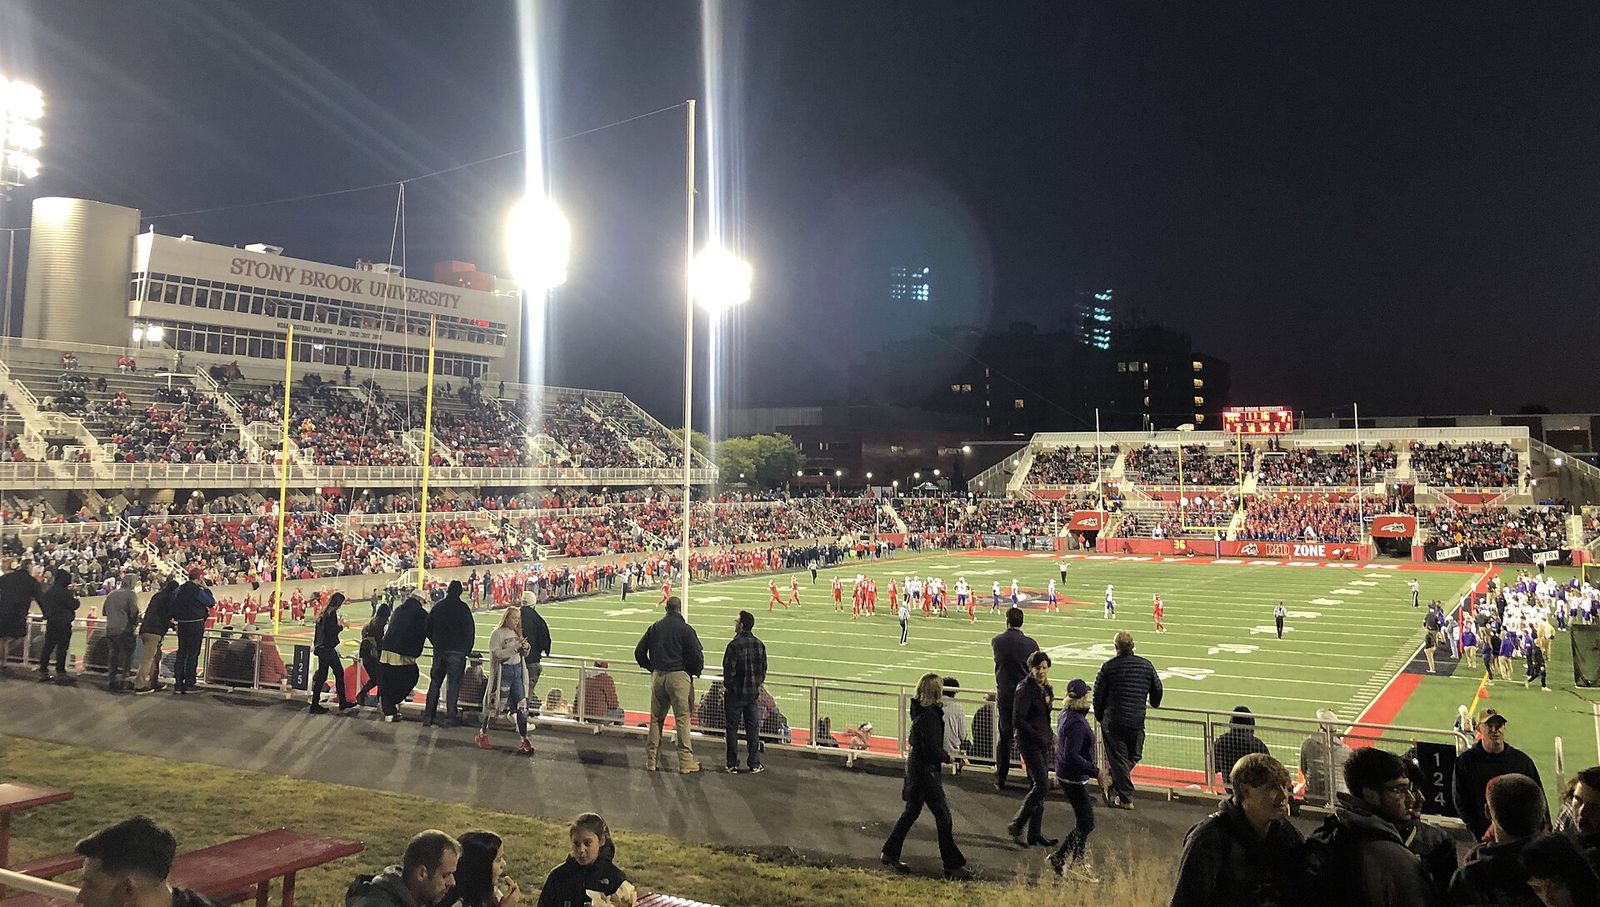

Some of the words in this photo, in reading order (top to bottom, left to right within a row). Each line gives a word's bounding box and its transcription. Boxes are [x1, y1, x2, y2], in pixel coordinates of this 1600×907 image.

[230, 257, 296, 283] STONY
[299, 270, 364, 294] BROOK
[369, 281, 461, 308] UNIVERSITY
[1293, 544, 1326, 557] ZONE
